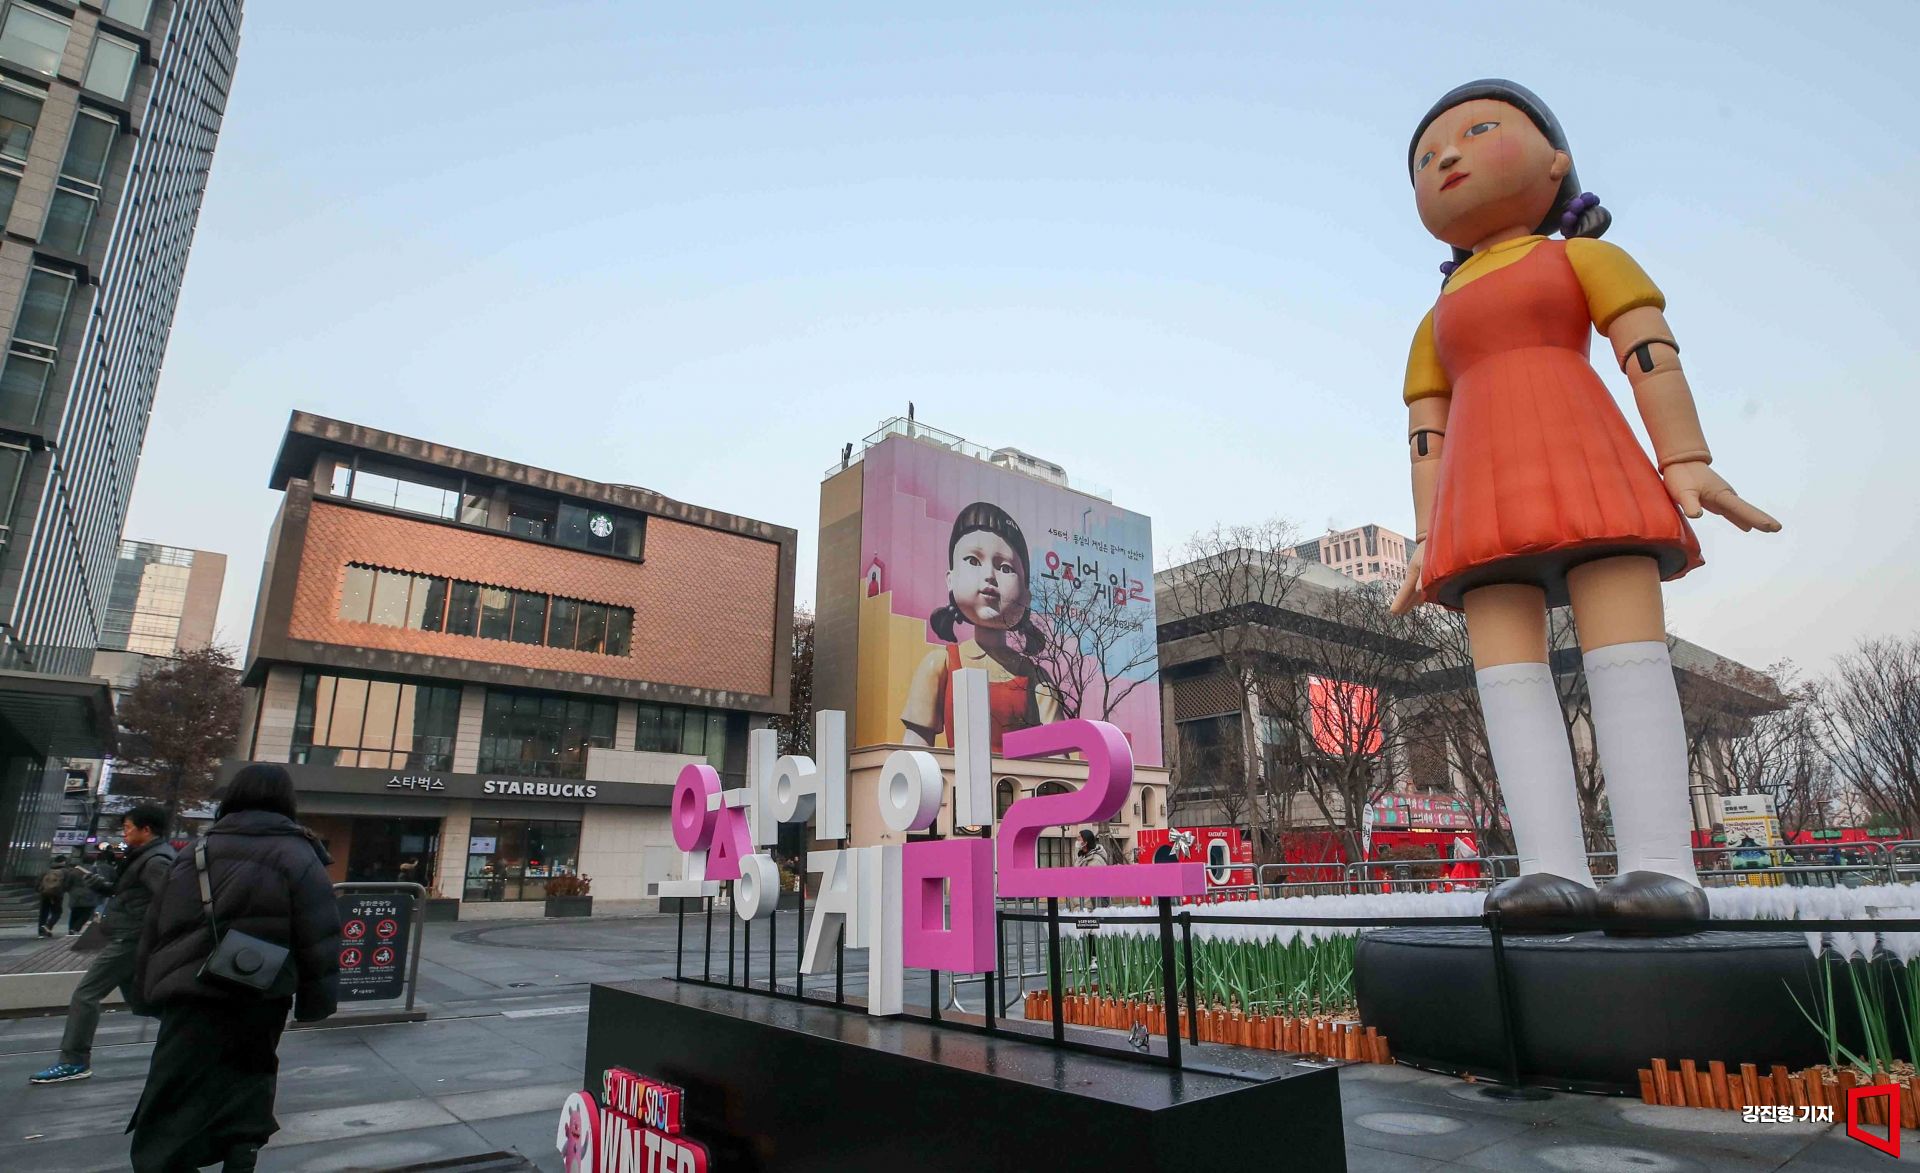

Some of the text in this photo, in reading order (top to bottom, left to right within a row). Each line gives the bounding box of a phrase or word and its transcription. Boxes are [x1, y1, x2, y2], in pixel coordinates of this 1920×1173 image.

[1041, 551, 1099, 590] 오징어
[387, 775, 445, 790] 스타벅스
[484, 780, 597, 799] STARBUCKS
[657, 709, 847, 921] 오징어
[57, 832, 86, 841] 부동산
